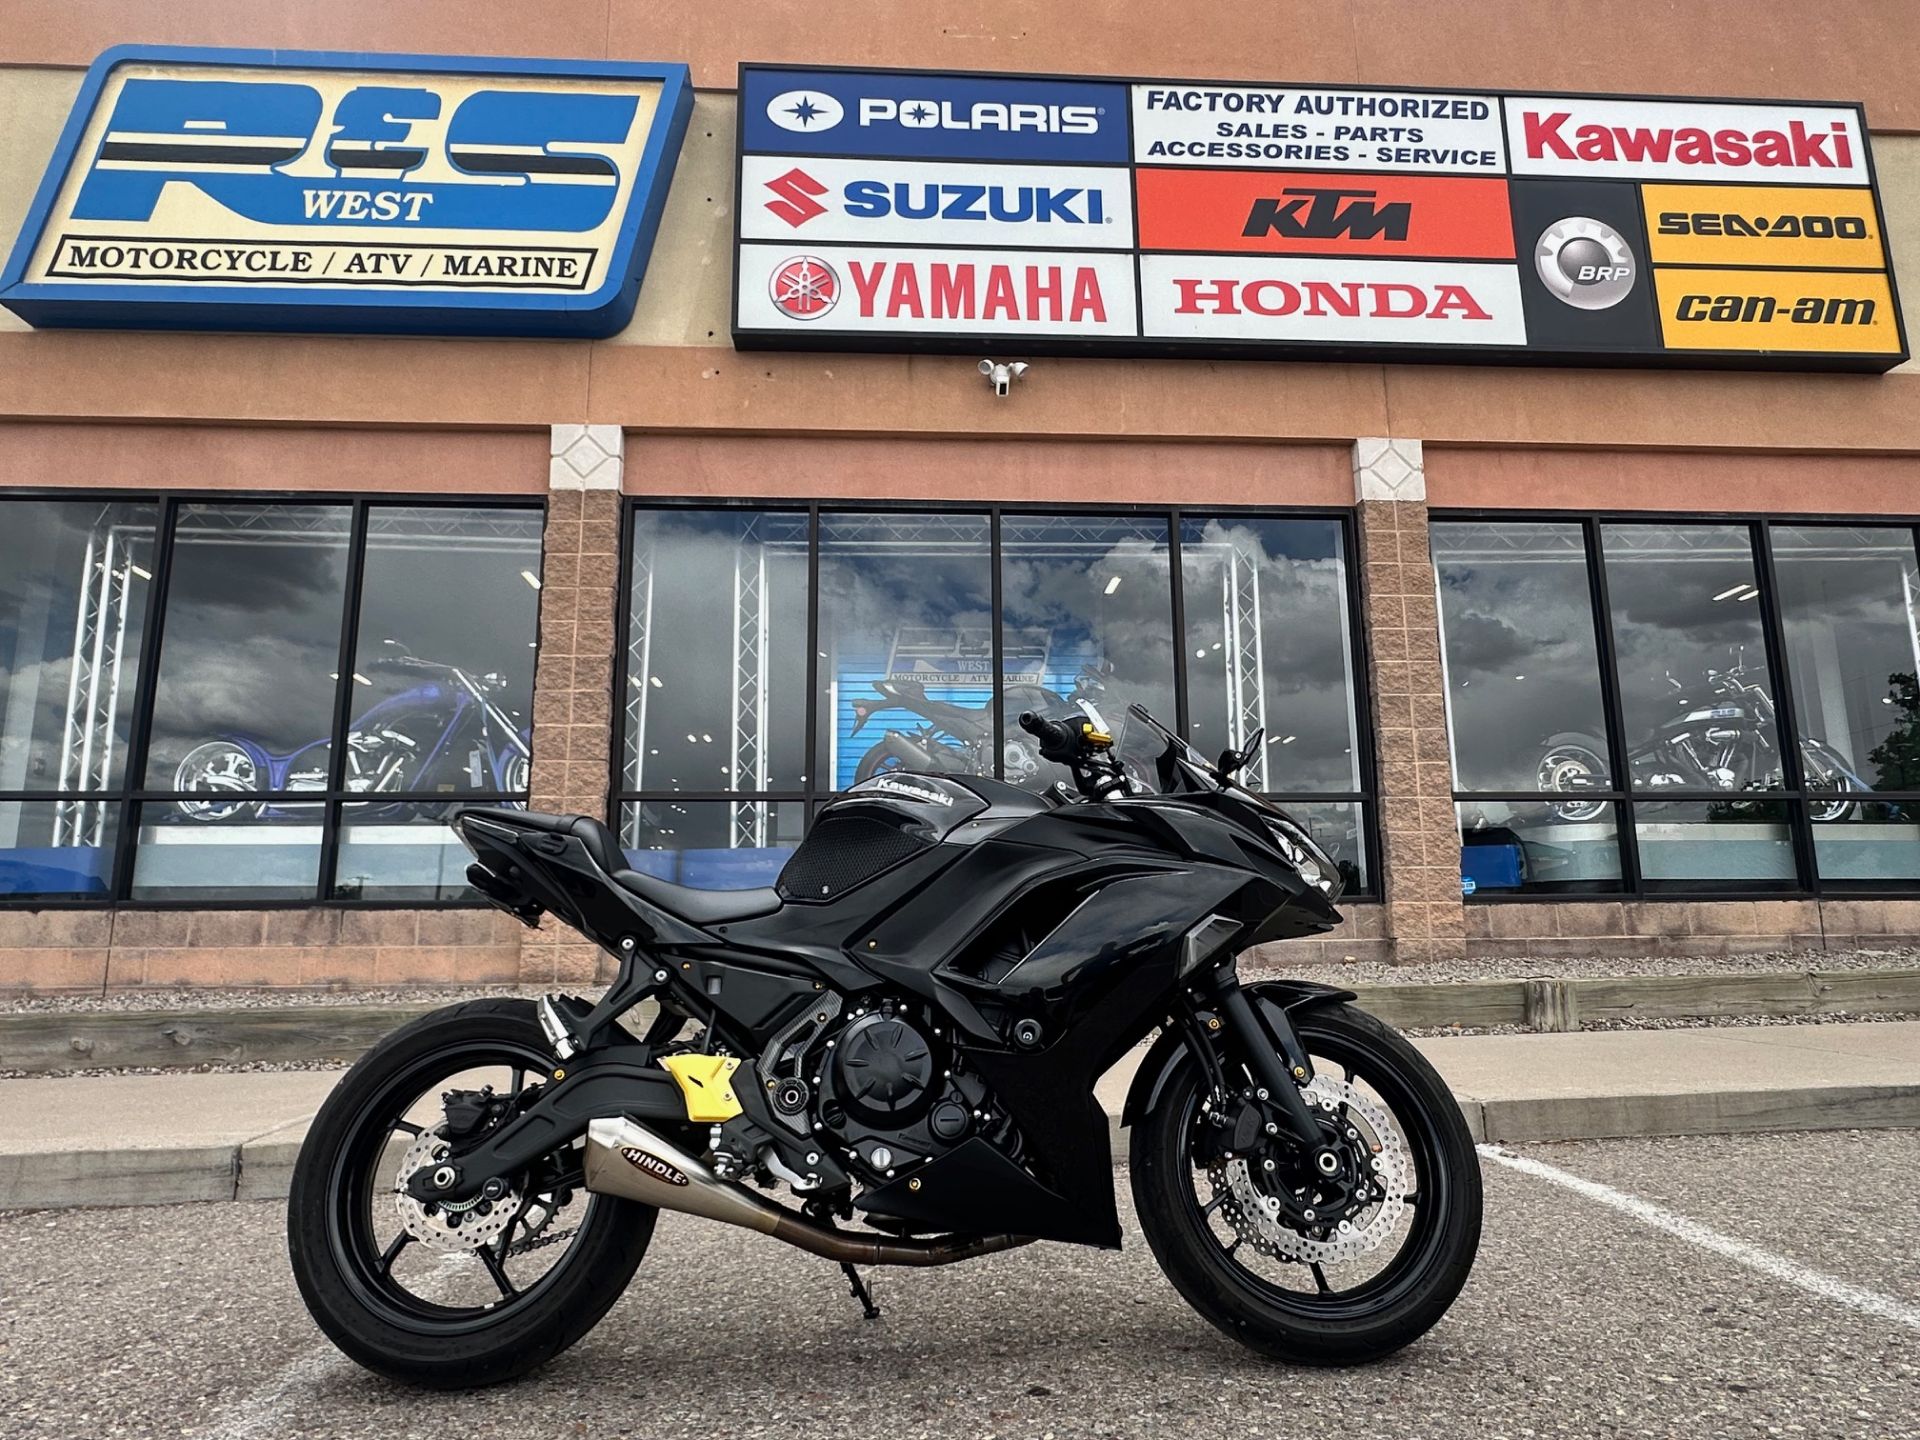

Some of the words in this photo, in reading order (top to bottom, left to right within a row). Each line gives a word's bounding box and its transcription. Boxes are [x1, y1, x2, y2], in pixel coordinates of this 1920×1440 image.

[859, 98, 1098, 134] POLARIS
[1146, 91, 1284, 113] FACTORY
[1294, 95, 1489, 120] AUTHORIZED
[1216, 122, 1307, 139] SALES
[1333, 126, 1424, 143] PARTS
[1522, 111, 1853, 168] Kawasaki
[1147, 141, 1350, 161] ACCESSORIES
[1376, 147, 1496, 166] SERVICE
[302, 189, 433, 221] WEST
[843, 180, 1104, 225] SUZUKI
[1241, 187, 1412, 242] KTM
[68, 245, 312, 273] MOTORCYCLE
[344, 252, 412, 275] ATV
[442, 254, 578, 279] MARINE
[1576, 265, 1631, 282] BRP
[847, 261, 1108, 323] YAMAHA
[1172, 279, 1494, 320] HONDA
[894, 674, 960, 682] MOTORCYCLE
[957, 660, 990, 671] WEST
[877, 778, 954, 807] Kawasaki
[626, 1149, 684, 1183] HINDLE
